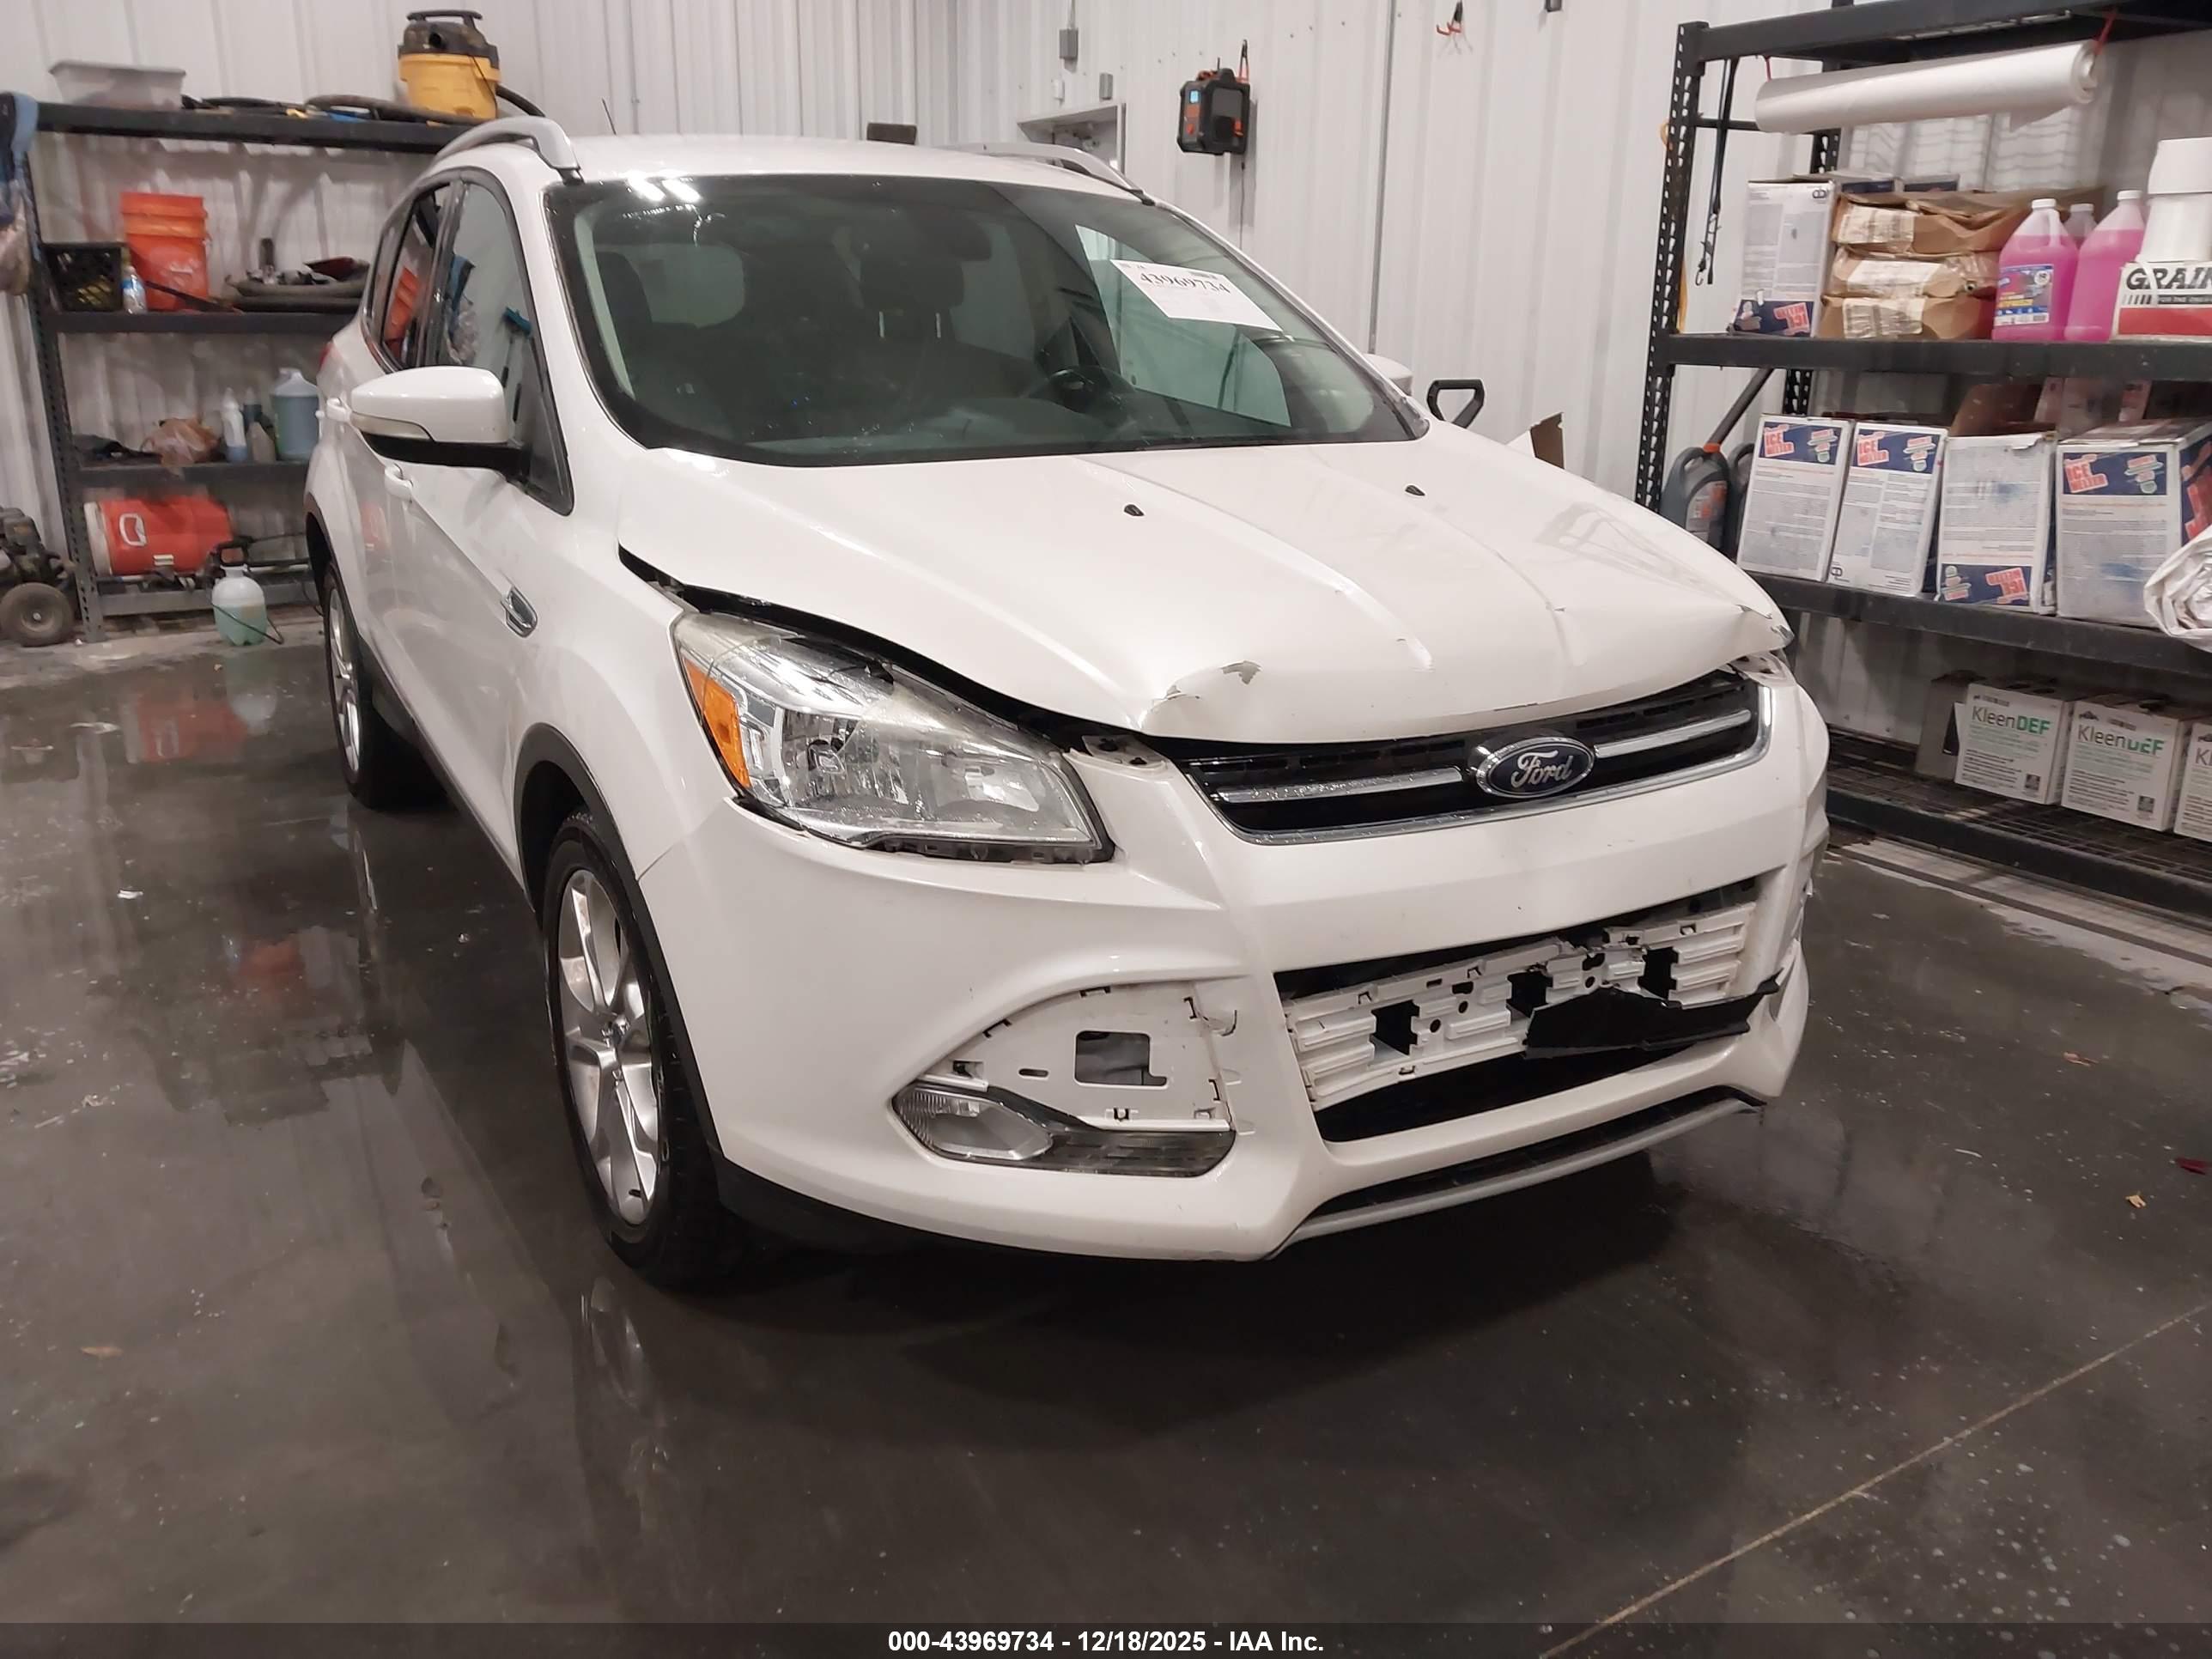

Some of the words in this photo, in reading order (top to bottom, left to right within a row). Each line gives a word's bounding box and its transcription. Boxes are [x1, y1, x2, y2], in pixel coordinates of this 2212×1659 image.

[1139, 271, 1231, 295] 43969734
[1972, 705, 2051, 735] KleenDEF
[1510, 749, 1574, 788] Ford
